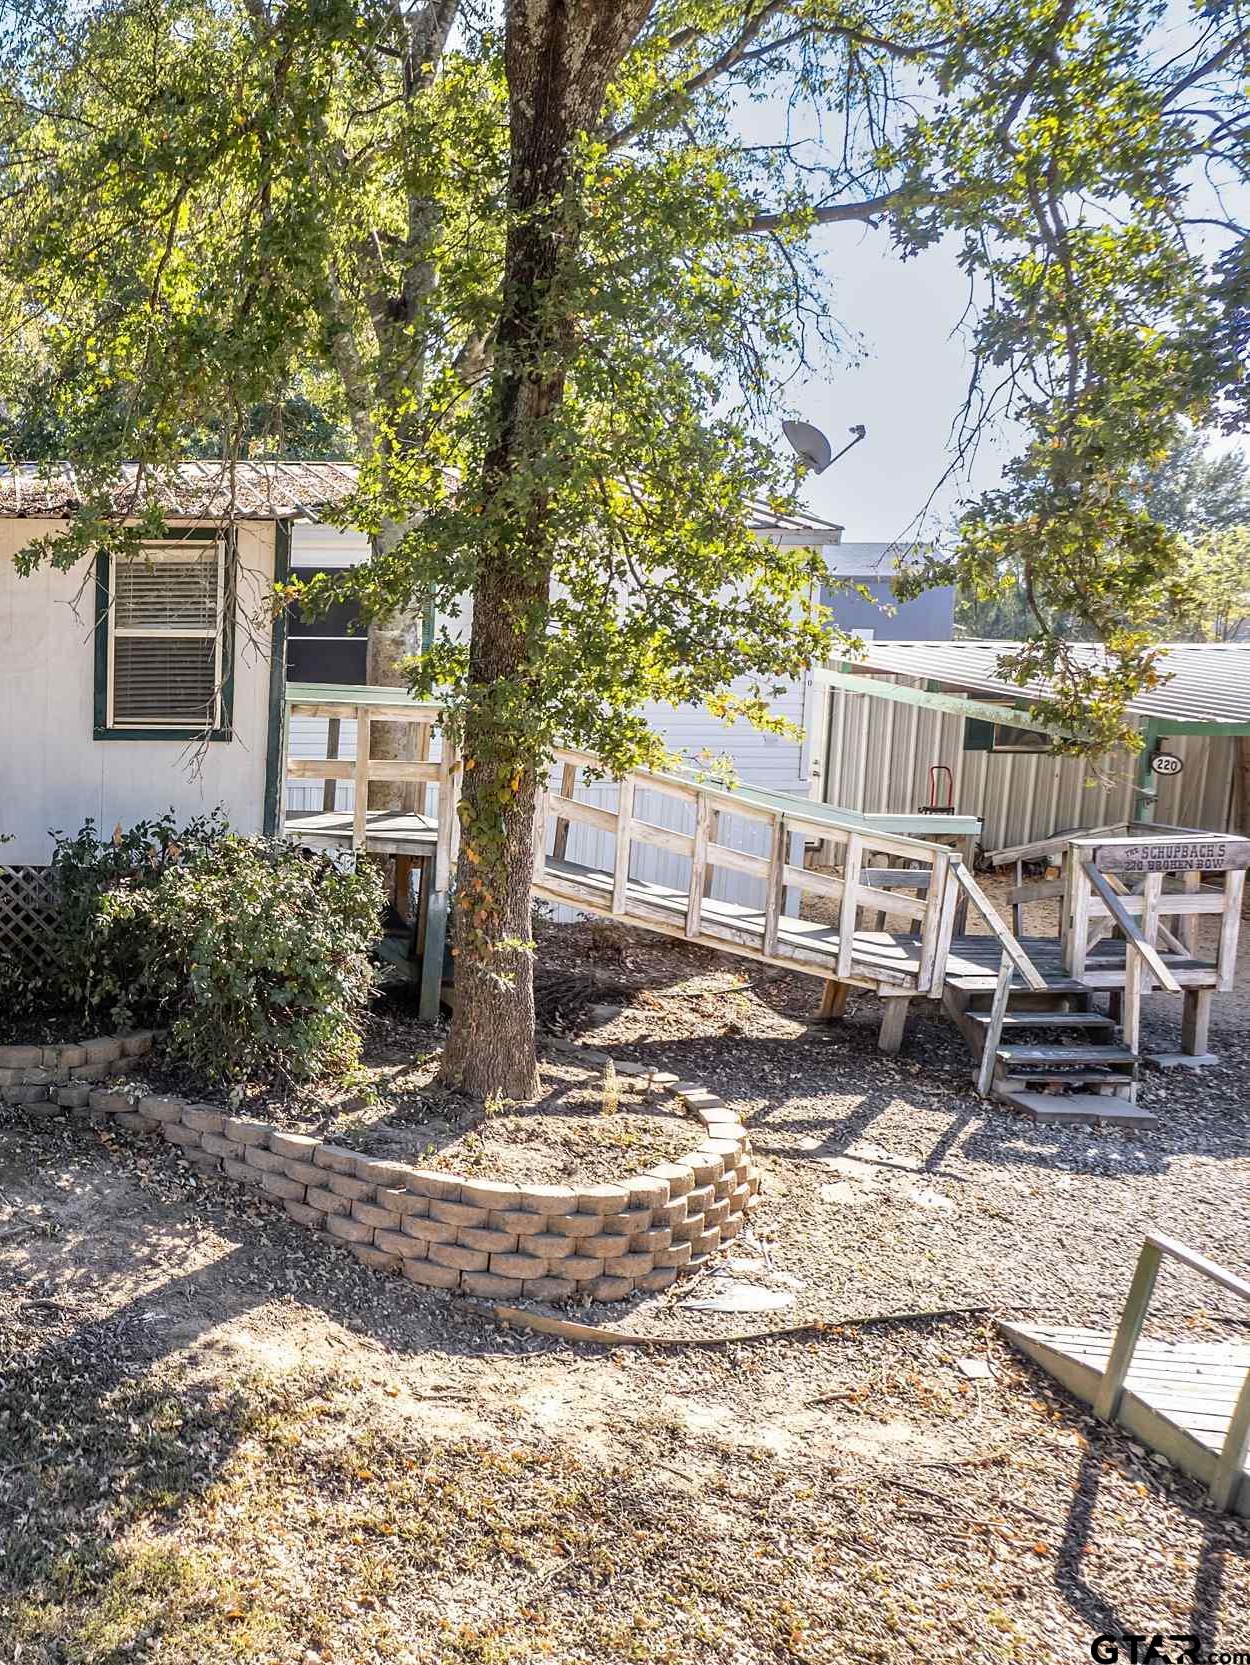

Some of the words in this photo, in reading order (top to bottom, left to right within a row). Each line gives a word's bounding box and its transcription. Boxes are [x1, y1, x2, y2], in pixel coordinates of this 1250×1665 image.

[1157, 759, 1178, 771] 220
[1125, 847, 1139, 857] THE
[1141, 845, 1226, 859] SCHUPBACH'S
[1124, 860, 1143, 871] 220
[1147, 859, 1193, 870] BROKEN
[1196, 858, 1225, 869] BOW
